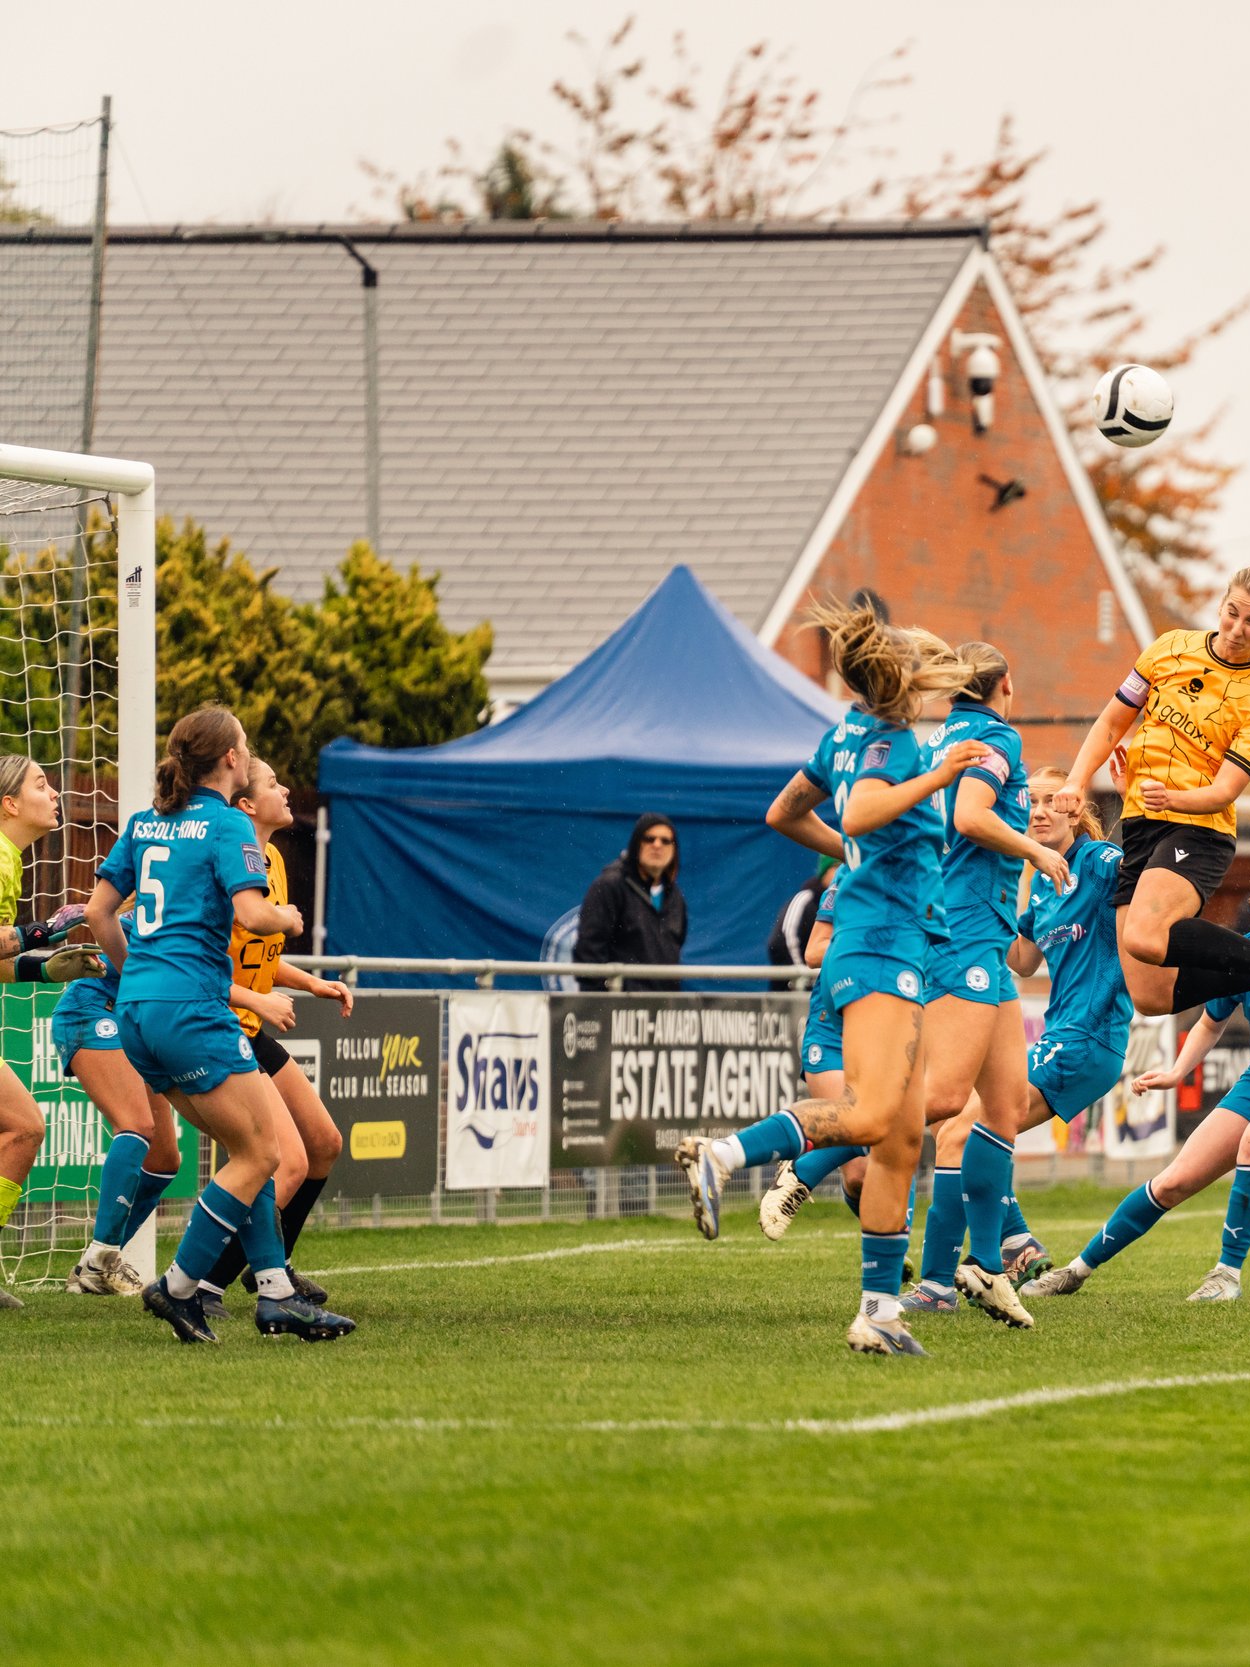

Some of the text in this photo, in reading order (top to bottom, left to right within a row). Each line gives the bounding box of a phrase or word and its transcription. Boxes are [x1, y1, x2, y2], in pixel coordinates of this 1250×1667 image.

[1158, 704, 1214, 752] galaxy
[136, 845, 171, 937] 5
[611, 1009, 792, 1048] MULTI-AWARD WINNING LOCAL
[336, 1033, 422, 1082] FOLLOW YOUR
[329, 1074, 428, 1099] CLUB ALL SEASON
[610, 1049, 698, 1120] ESTATE
[701, 1049, 795, 1119] AGENTS
[33, 1101, 108, 1167] TIONAL
